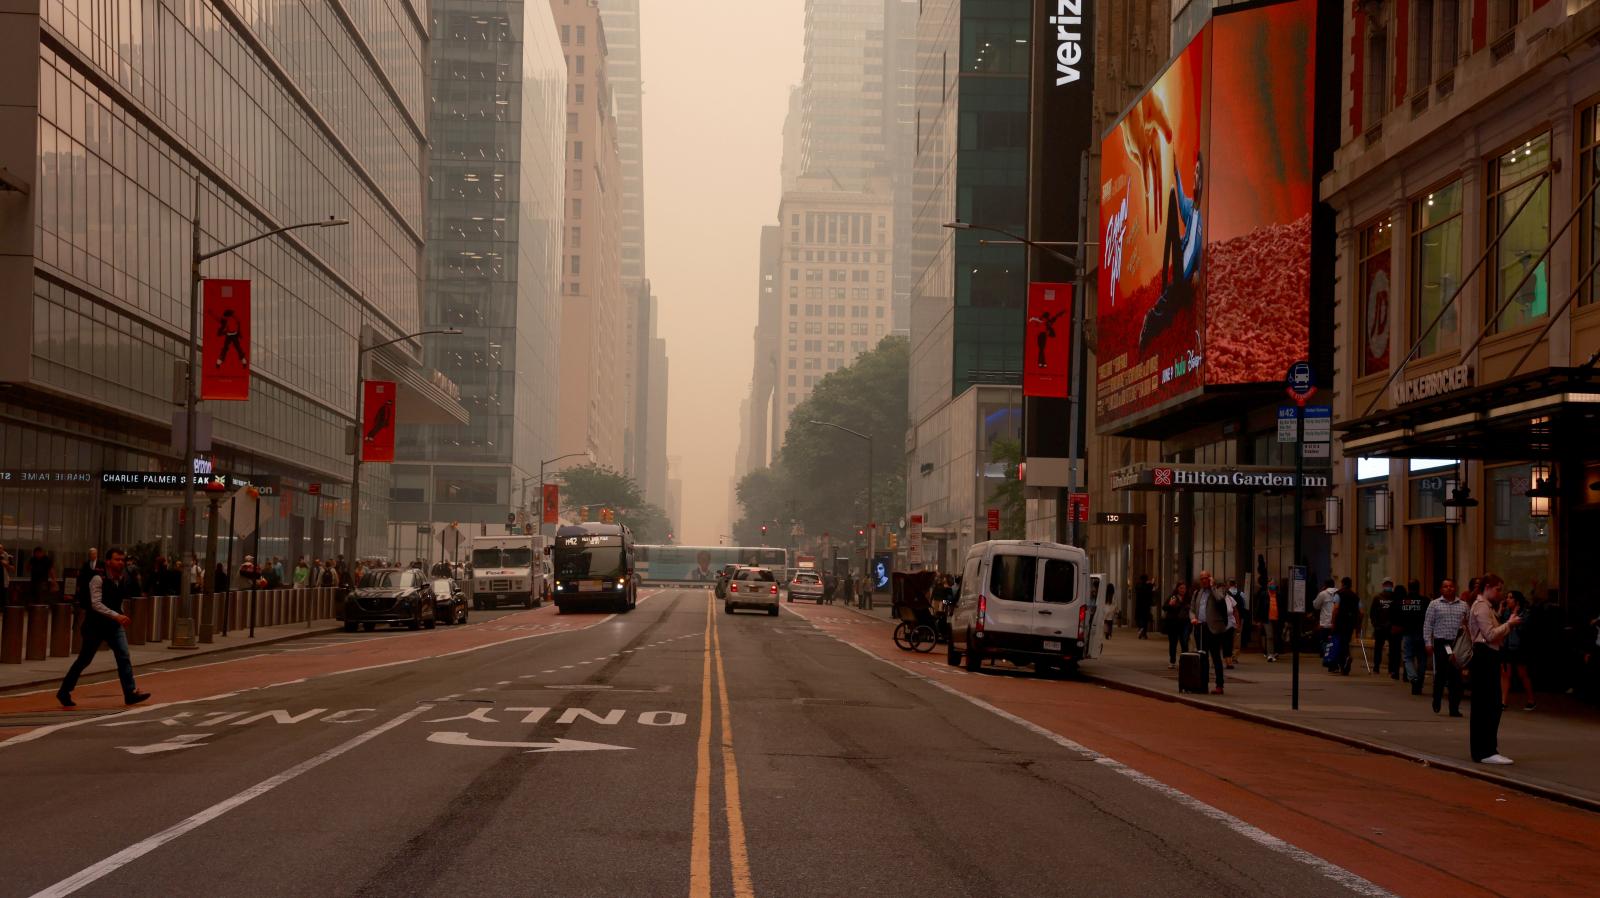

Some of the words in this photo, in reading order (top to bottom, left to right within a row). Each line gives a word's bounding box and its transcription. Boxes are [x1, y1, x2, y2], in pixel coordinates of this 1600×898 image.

[1049, 0, 1082, 86] veriz
[103, 474, 139, 484] CHARLIE
[143, 474, 177, 484] PALMER
[181, 475, 209, 485] SEAK
[1174, 470, 1228, 485] Hilton
[1232, 472, 1293, 487] Garden
[420, 707, 687, 726] ONLY
